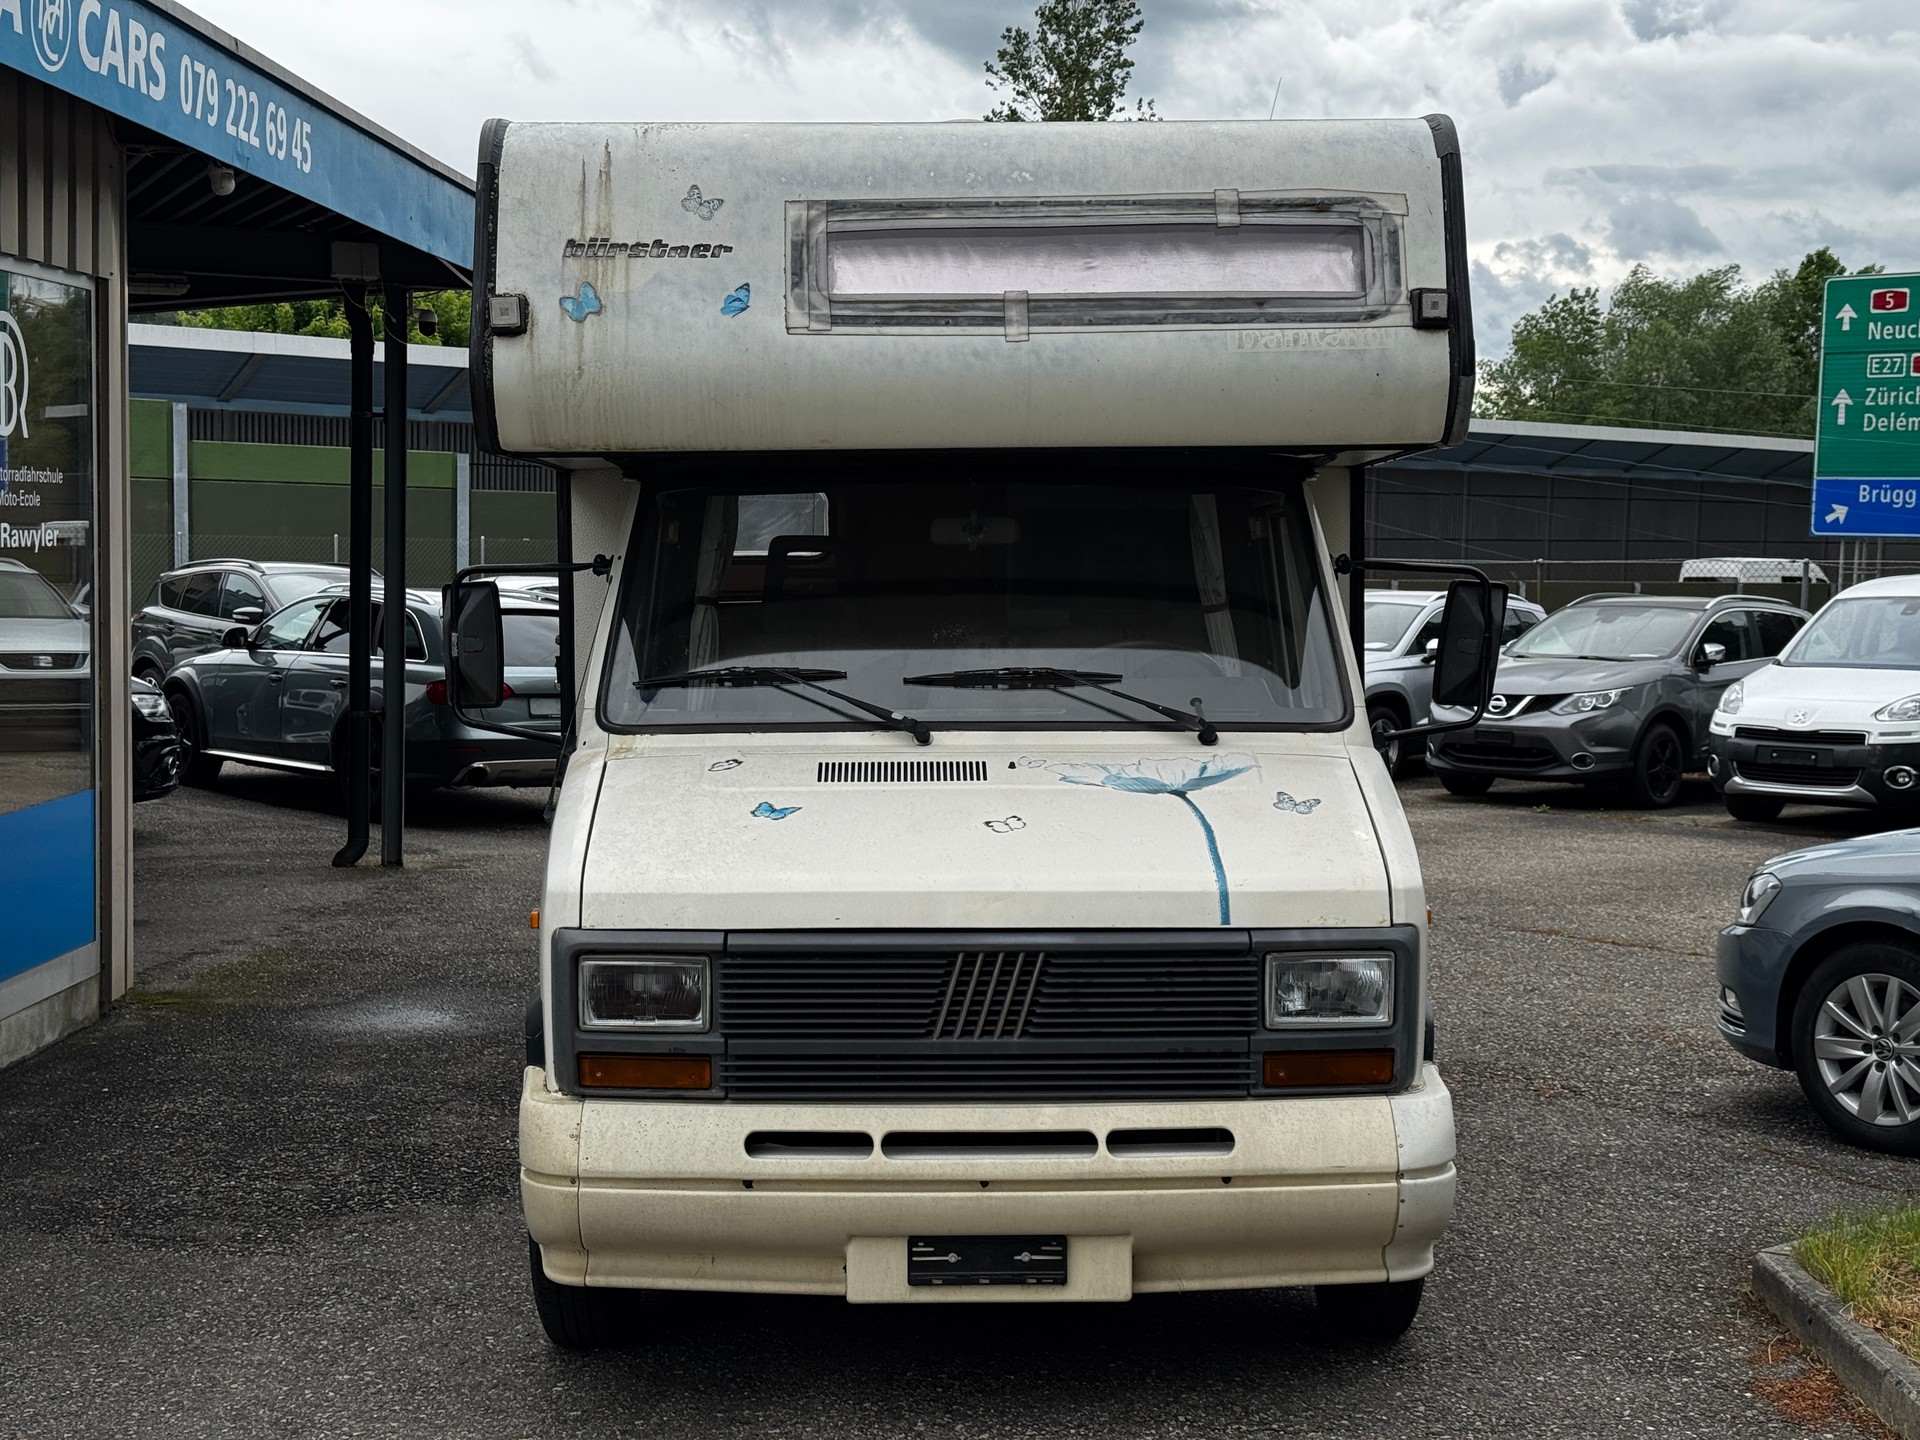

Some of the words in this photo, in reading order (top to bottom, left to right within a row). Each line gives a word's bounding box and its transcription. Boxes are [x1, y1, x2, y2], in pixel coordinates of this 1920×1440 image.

[78, 0, 166, 101] CARS
[180, 54, 218, 127] 079
[225, 78, 260, 149] 222
[265, 101, 287, 161] 69
[291, 117, 312, 174] 45
[563, 237, 734, 259] bürstner
[1885, 293, 1895, 309] 5
[1871, 358, 1902, 374] E27
[1863, 411, 1920, 432] Delém
[1859, 484, 1917, 508] Brügg
[0, 522, 60, 553] Rawyler
